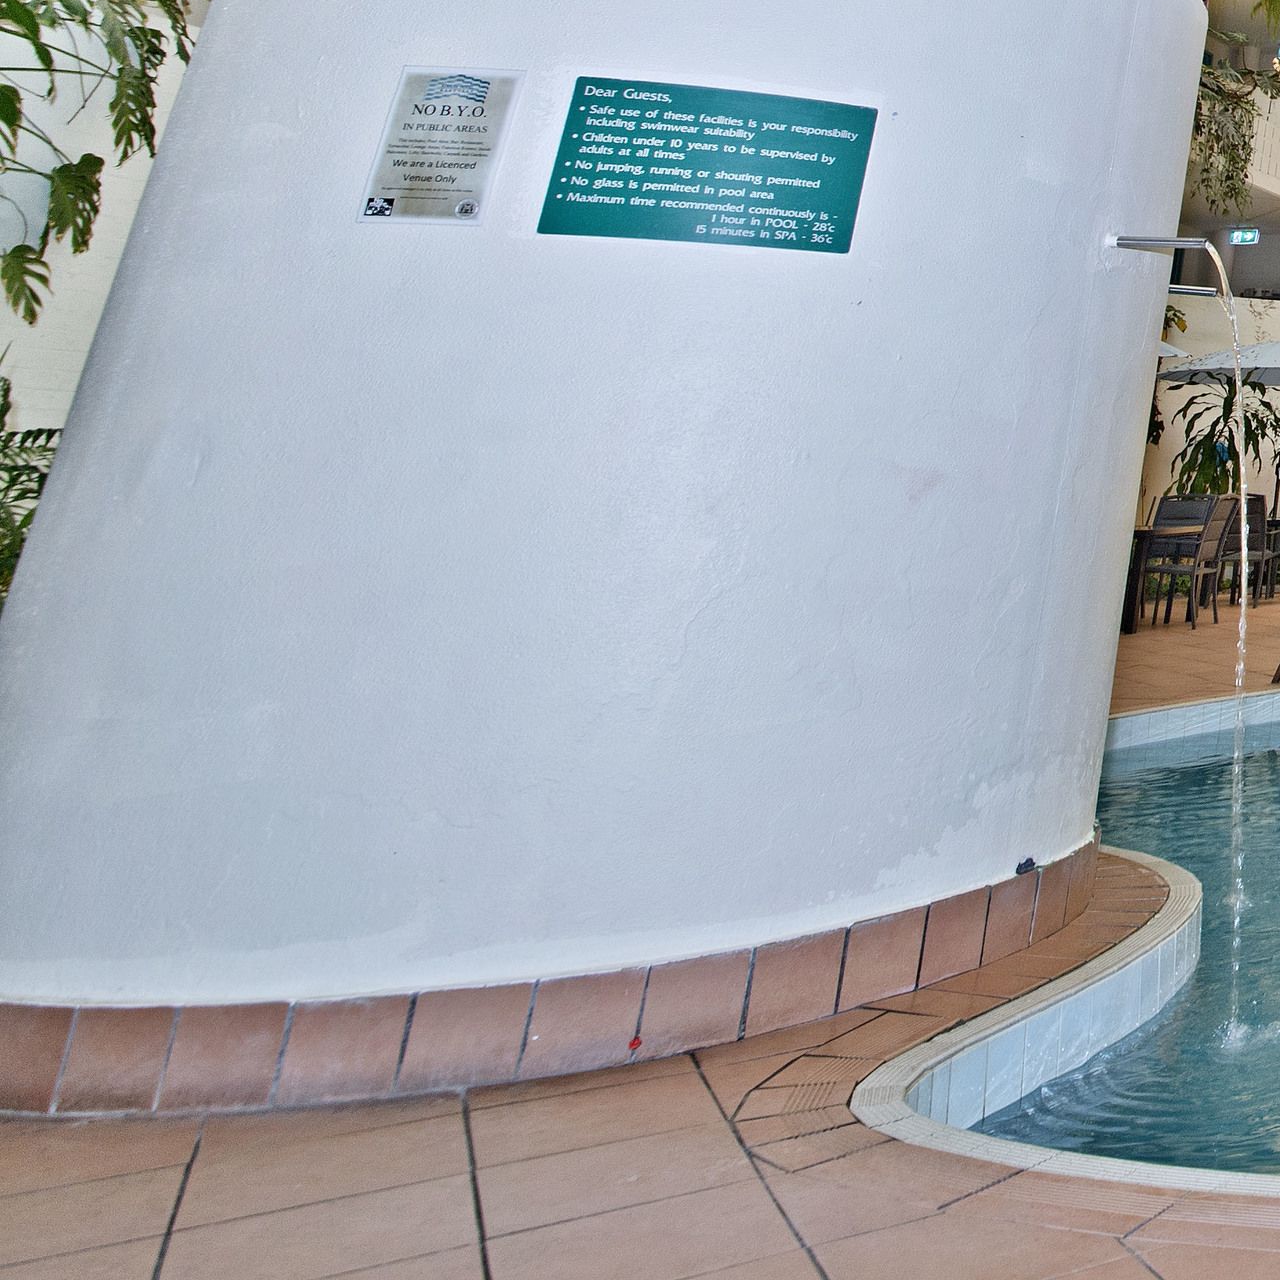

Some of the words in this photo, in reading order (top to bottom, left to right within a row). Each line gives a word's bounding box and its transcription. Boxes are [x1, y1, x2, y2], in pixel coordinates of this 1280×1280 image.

[584, 85, 617, 97] Dear
[623, 88, 672, 103] Guests,
[411, 104, 436, 116] NO
[440, 105, 487, 118] B.Y.O.
[402, 123, 415, 131] IN
[415, 123, 452, 132] PUBLIC
[454, 125, 488, 133] AREAS
[586, 117, 636, 131] including
[640, 121, 699, 134] swimwear
[703, 126, 755, 141] suitability
[589, 105, 616, 115] Safe
[620, 108, 641, 117] use
[645, 109, 658, 119] of
[663, 111, 695, 122] these
[699, 114, 743, 126] facilities
[748, 119, 757, 127] is
[761, 122, 787, 132] your
[791, 124, 859, 141] responsibility
[579, 145, 614, 155] adults
[618, 148, 631, 156] at
[636, 148, 650, 157] all
[653, 150, 686, 160] times
[582, 132, 628, 144] Children
[632, 136, 666, 147] under
[670, 139, 683, 148] 10
[687, 141, 719, 151] years
[723, 144, 736, 153] to
[740, 145, 756, 155] be
[760, 148, 818, 161] supervised
[821, 153, 837, 165] by
[392, 159, 408, 168] We
[435, 160, 477, 170] Licenced
[403, 174, 433, 182] Venue
[434, 174, 458, 185] Only
[575, 159, 592, 170] No
[595, 161, 645, 175] jumping,
[650, 166, 693, 179] running
[697, 170, 710, 178] or
[714, 170, 763, 185] shouting
[766, 176, 821, 189] permitted
[570, 176, 588, 186] No
[592, 177, 624, 189] glass
[628, 180, 638, 189] is
[642, 181, 700, 193] permitted
[704, 185, 714, 195] in
[718, 187, 746, 198] pool
[749, 191, 775, 200] area
[566, 192, 625, 205] Maximum
[630, 196, 657, 207] time
[660, 199, 744, 213] recommended
[748, 205, 817, 221] continuously
[820, 211, 829, 220] is
[711, 214, 716, 223] 1
[720, 214, 746, 225] hour
[750, 217, 760, 226] in
[765, 218, 799, 230] POOL
[695, 225, 707, 234] 15
[711, 226, 755, 238] minutes
[759, 229, 770, 238] in
[774, 230, 797, 240] SPA
